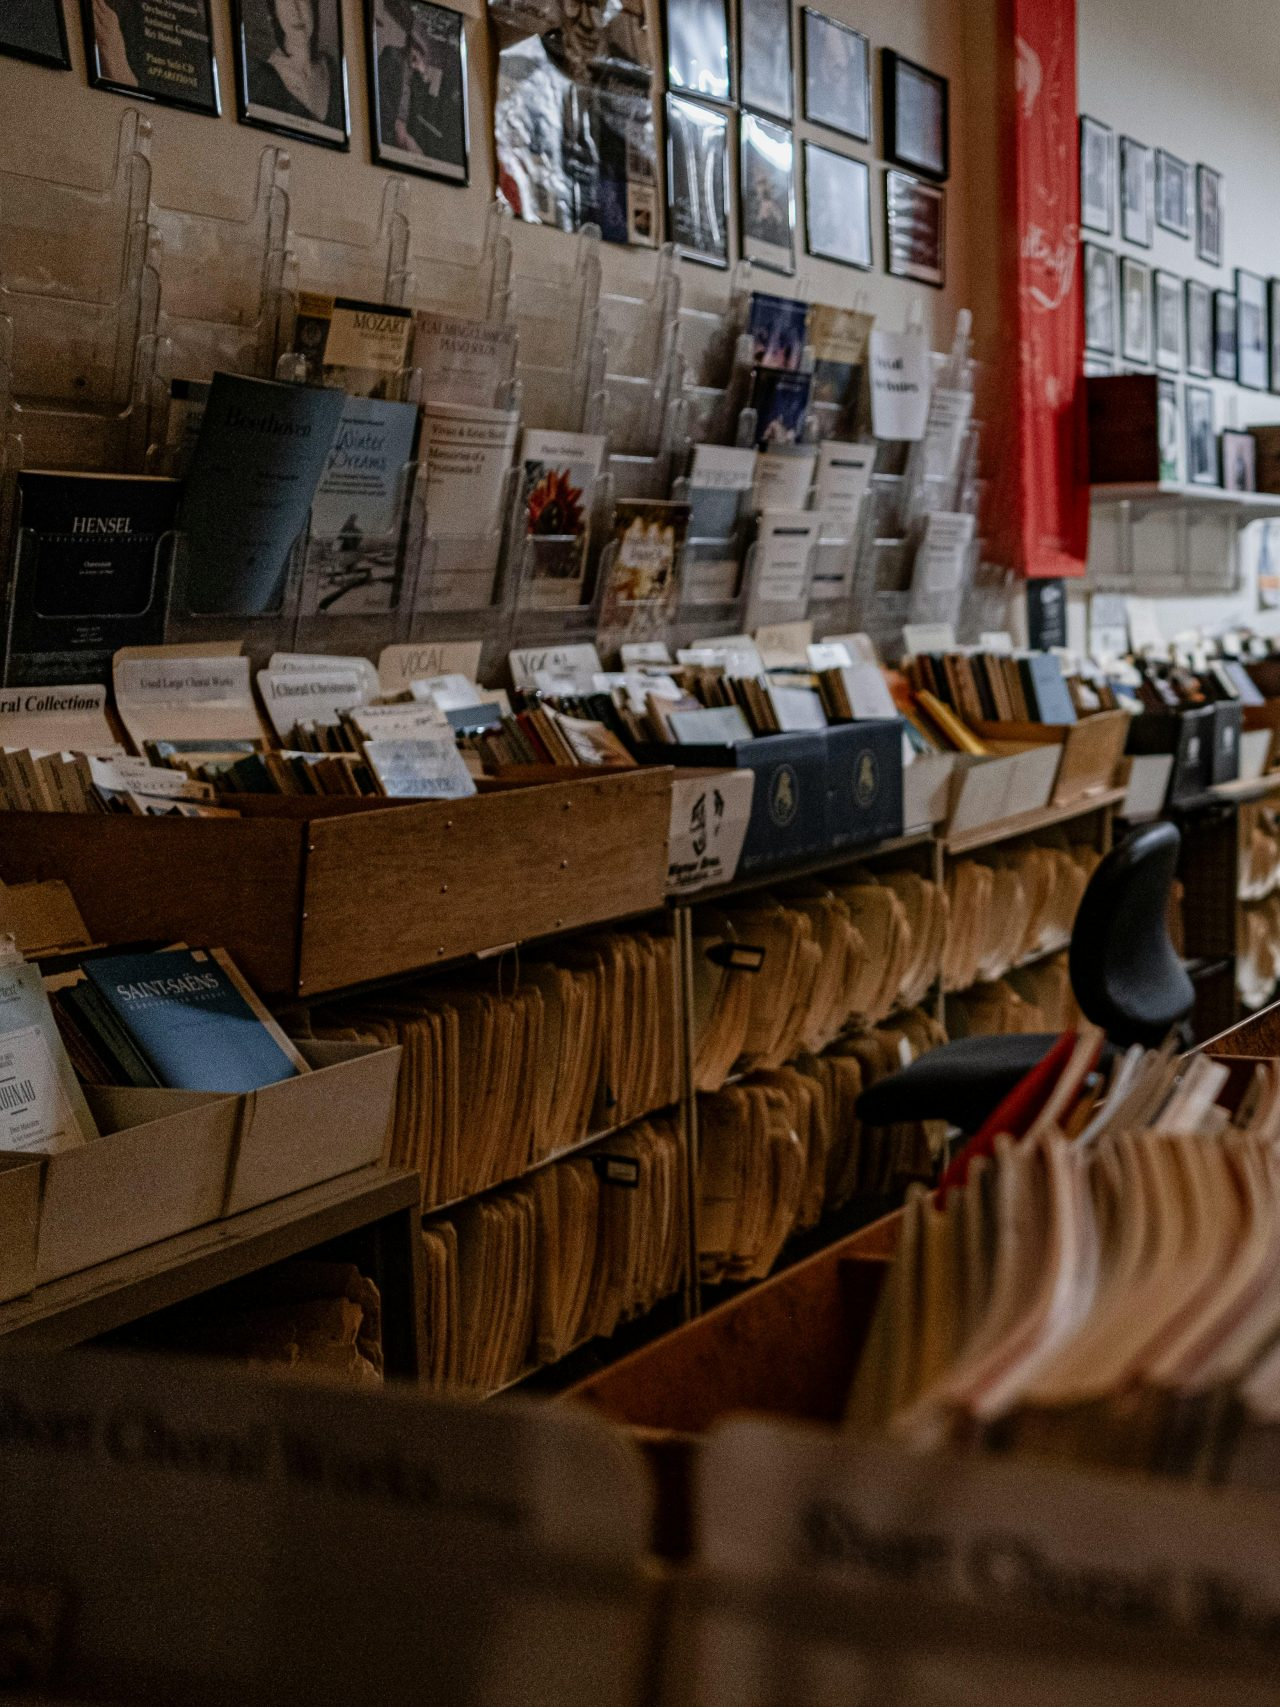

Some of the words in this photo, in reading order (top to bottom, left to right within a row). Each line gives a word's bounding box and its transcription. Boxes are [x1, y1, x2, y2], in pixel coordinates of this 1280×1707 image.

[353, 313, 407, 335] MOZART
[225, 406, 311, 437] Beethoven
[336, 425, 386, 451] Winter
[72, 516, 133, 534] HENSEL
[400, 648, 453, 678] VOCAL
[276, 682, 309, 697] Choral
[311, 681, 357, 694] Christmas
[0, 696, 21, 713] ral
[24, 695, 100, 712] Collections
[116, 972, 219, 1001] SAINT-SAËNS
